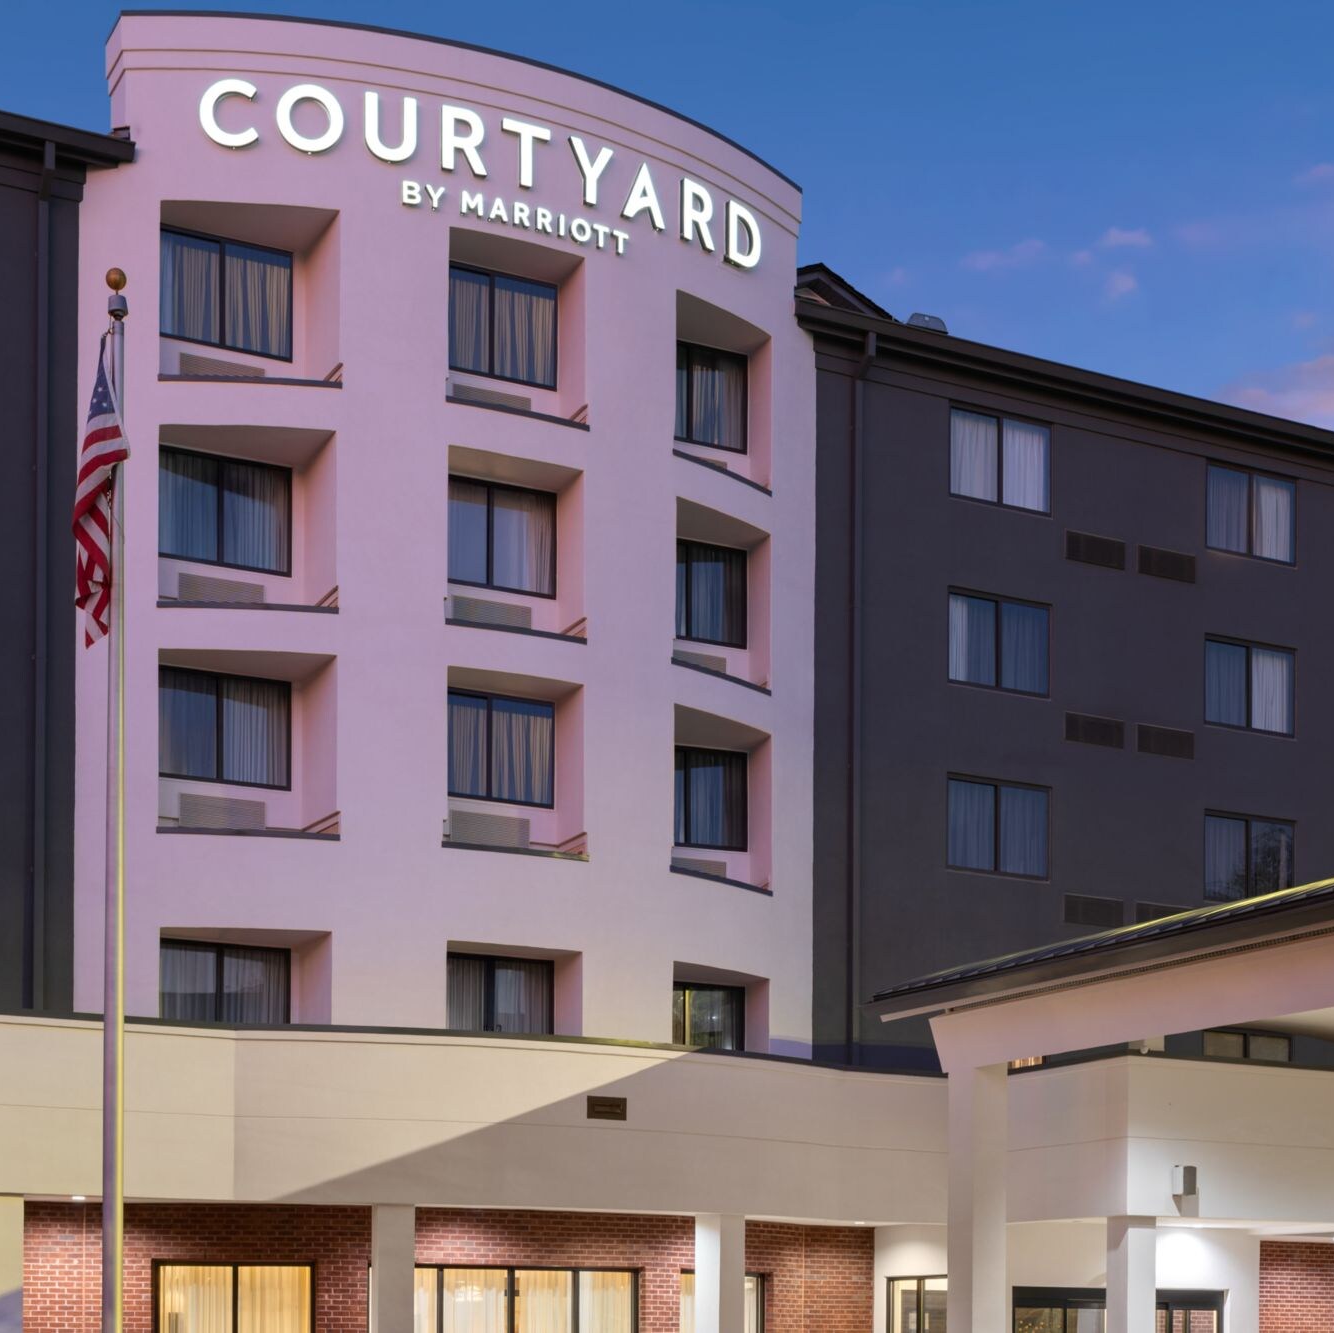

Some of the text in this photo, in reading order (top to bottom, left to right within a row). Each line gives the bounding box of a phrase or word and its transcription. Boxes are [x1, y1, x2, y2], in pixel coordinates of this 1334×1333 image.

[199, 78, 762, 269] COURTYARD
[402, 181, 629, 255] BY MARRIOTT
